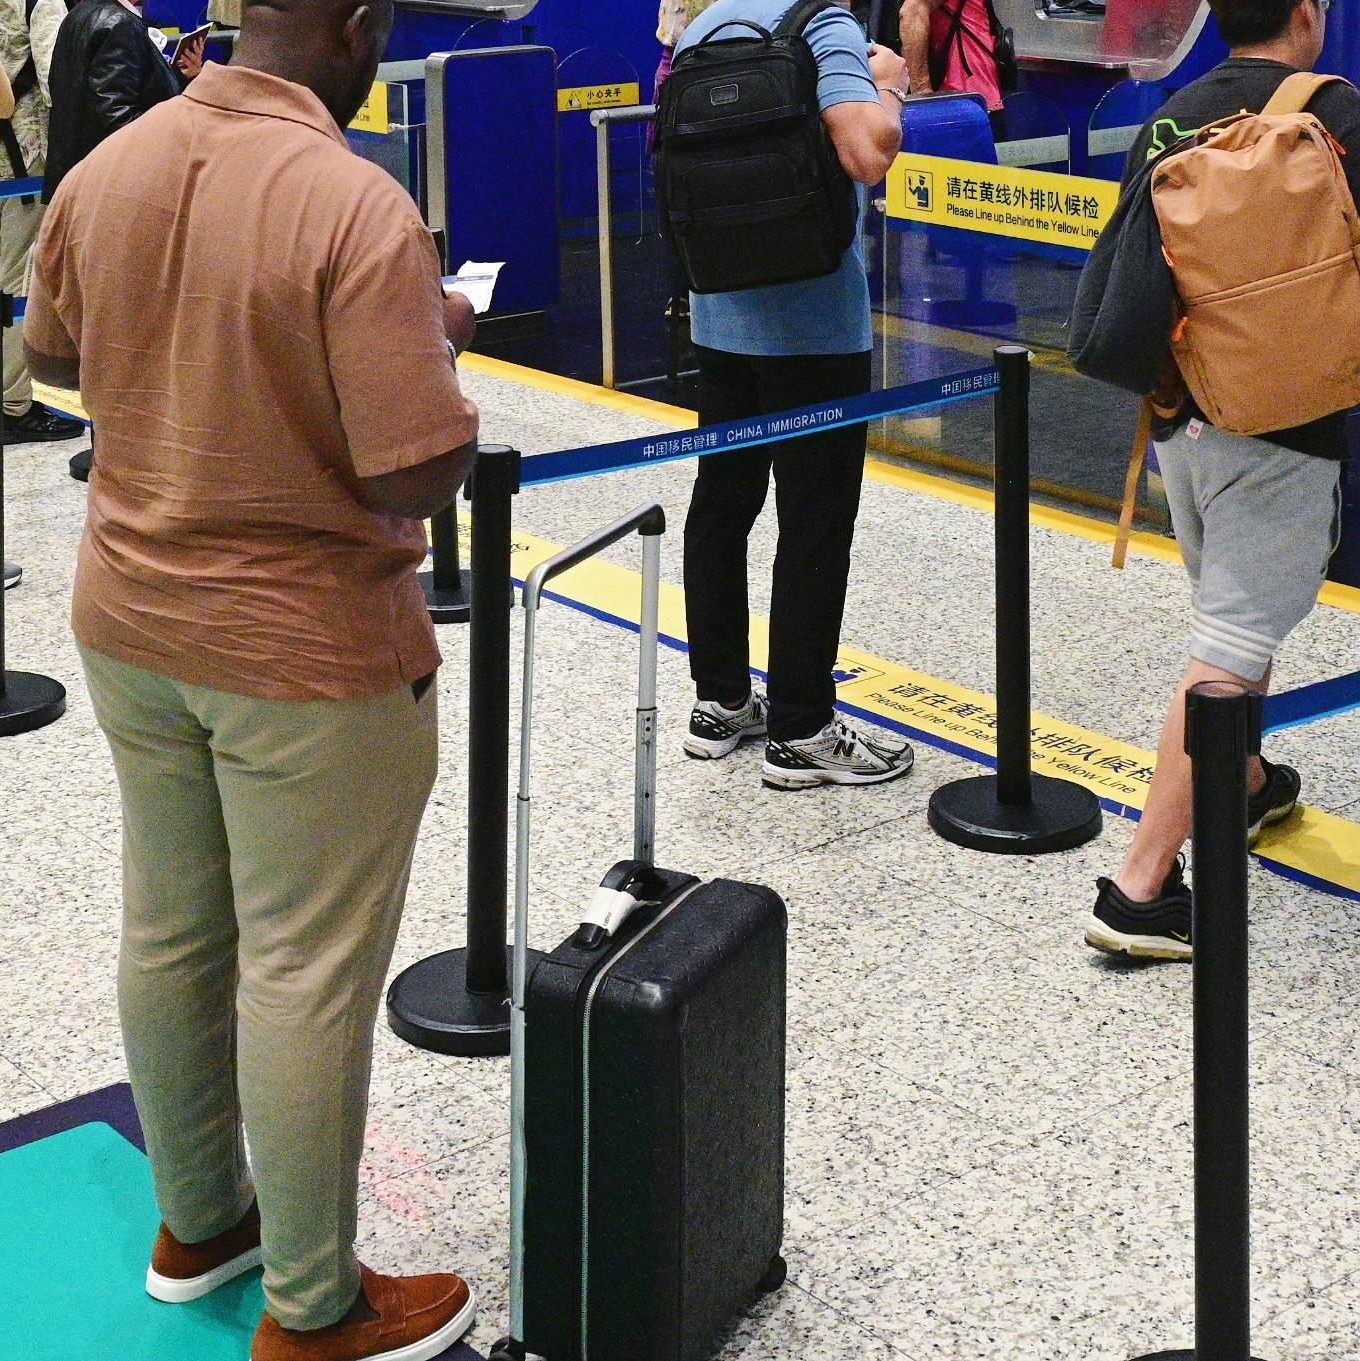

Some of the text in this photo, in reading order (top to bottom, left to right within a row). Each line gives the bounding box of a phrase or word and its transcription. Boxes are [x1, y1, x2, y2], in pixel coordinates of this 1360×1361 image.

[587, 87, 622, 99] 小心夹手
[946, 175, 1099, 220] 请在黄线外排队候检
[946, 203, 1100, 238] Please Line up Behind the Yellow Line
[727, 407, 844, 441] CHINA IMMIGRATION
[643, 431, 718, 458] 中国移民管理
[864, 692, 915, 713] Please
[912, 710, 947, 725] Line
[944, 723, 967, 732] up
[1048, 756, 1101, 780] Yellow
[1099, 777, 1137, 794] Line
